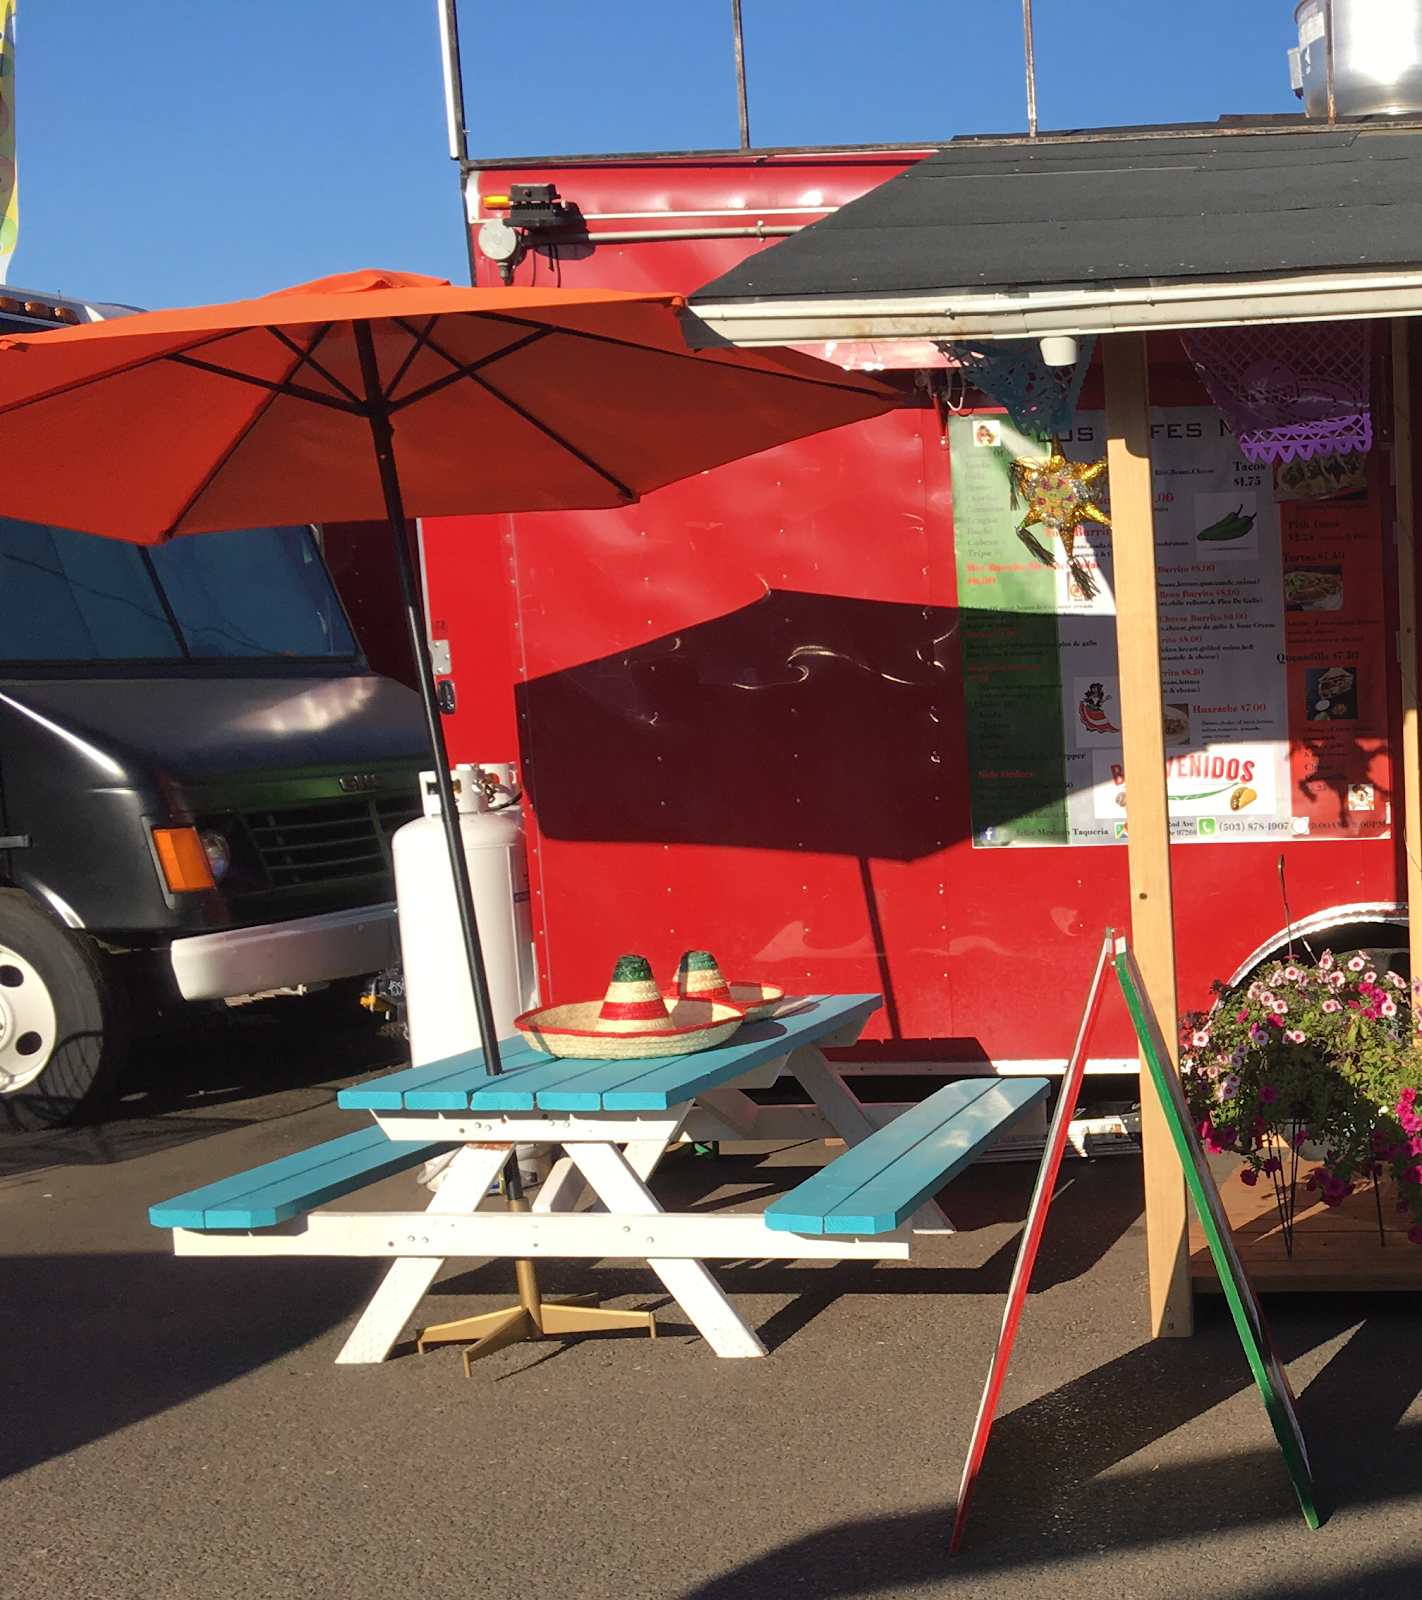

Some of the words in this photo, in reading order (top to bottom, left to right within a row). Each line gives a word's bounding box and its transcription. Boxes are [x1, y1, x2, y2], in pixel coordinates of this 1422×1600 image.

[1150, 422, 1202, 439] FES
[1233, 462, 1267, 472] Tacos
[1233, 476, 1261, 487] $1.75
[1074, 524, 1112, 537] Burrit
[968, 550, 992, 558] Tripa
[1182, 589, 1214, 598] Burrito
[1190, 613, 1222, 622] Burrito
[1192, 704, 1238, 714] Huarache
[1241, 703, 1267, 713] $7.00
[1111, 754, 1255, 787] BVENIDOS
[1072, 827, 1109, 837] Taqueria
[1219, 821, 1245, 833] (503)
[1247, 821, 1289, 832] 878-1907
